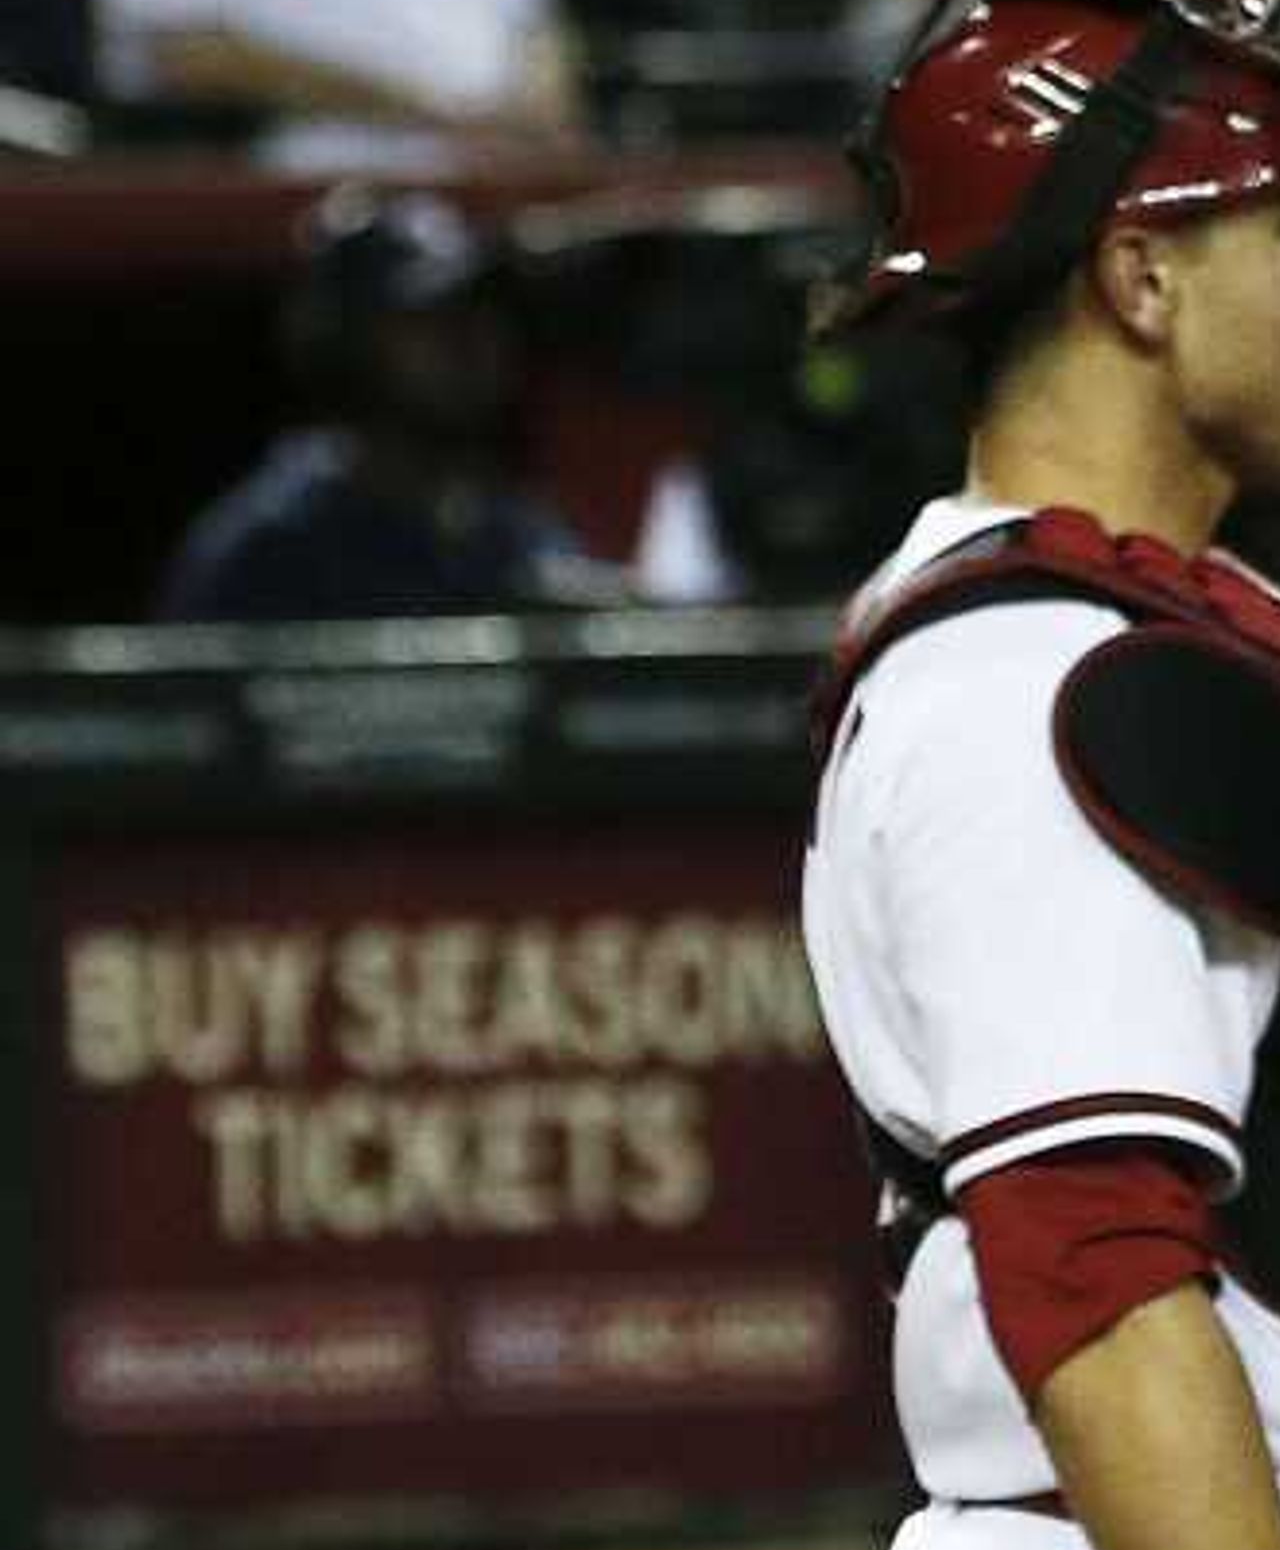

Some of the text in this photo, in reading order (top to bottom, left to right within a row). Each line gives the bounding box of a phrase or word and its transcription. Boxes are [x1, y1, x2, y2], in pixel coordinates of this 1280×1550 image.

[65, 913, 828, 1086] BUY SEASON
[197, 1078, 712, 1237] TICKETS
